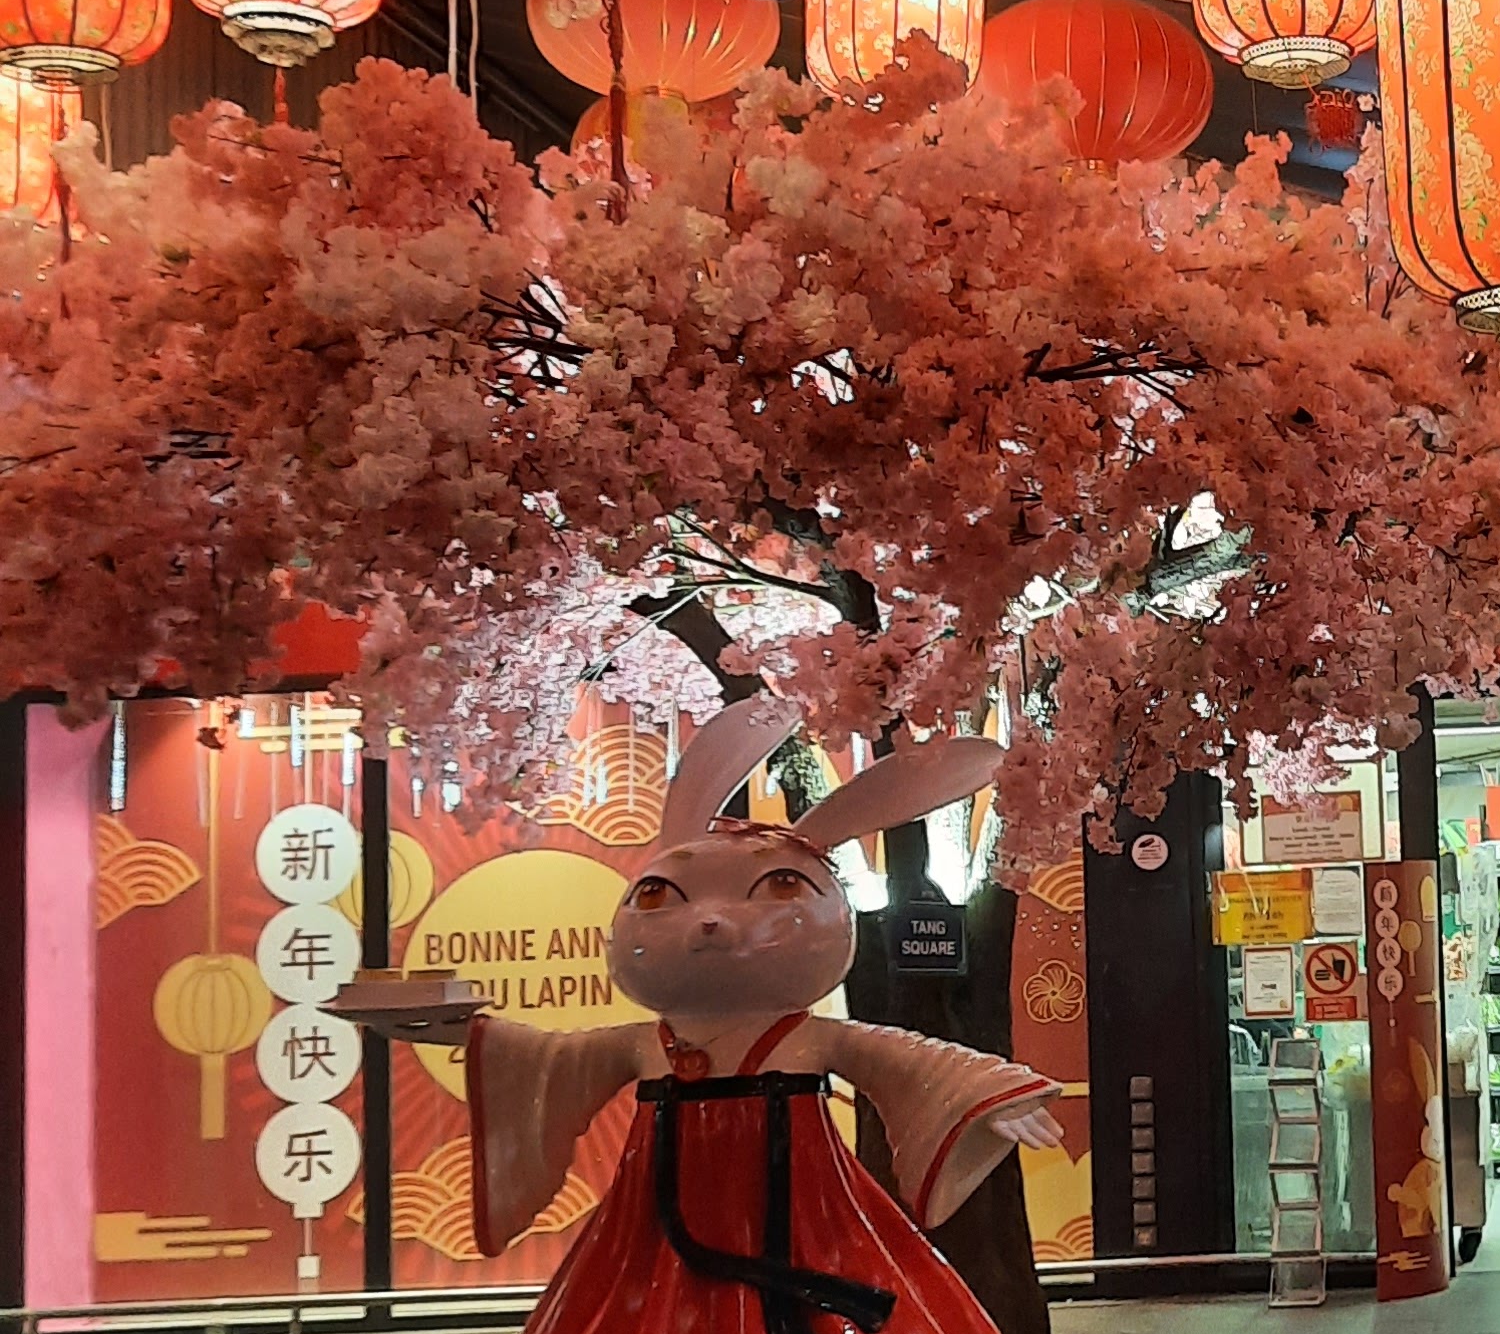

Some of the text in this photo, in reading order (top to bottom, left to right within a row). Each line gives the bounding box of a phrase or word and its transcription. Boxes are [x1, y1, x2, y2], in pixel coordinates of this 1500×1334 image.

[910, 920, 946, 935] TANG
[424, 929, 536, 965] BONNE
[901, 940, 957, 956] SQUARE
[280, 827, 337, 1183] 新年快乐
[469, 974, 612, 1010] DU LAPIN
